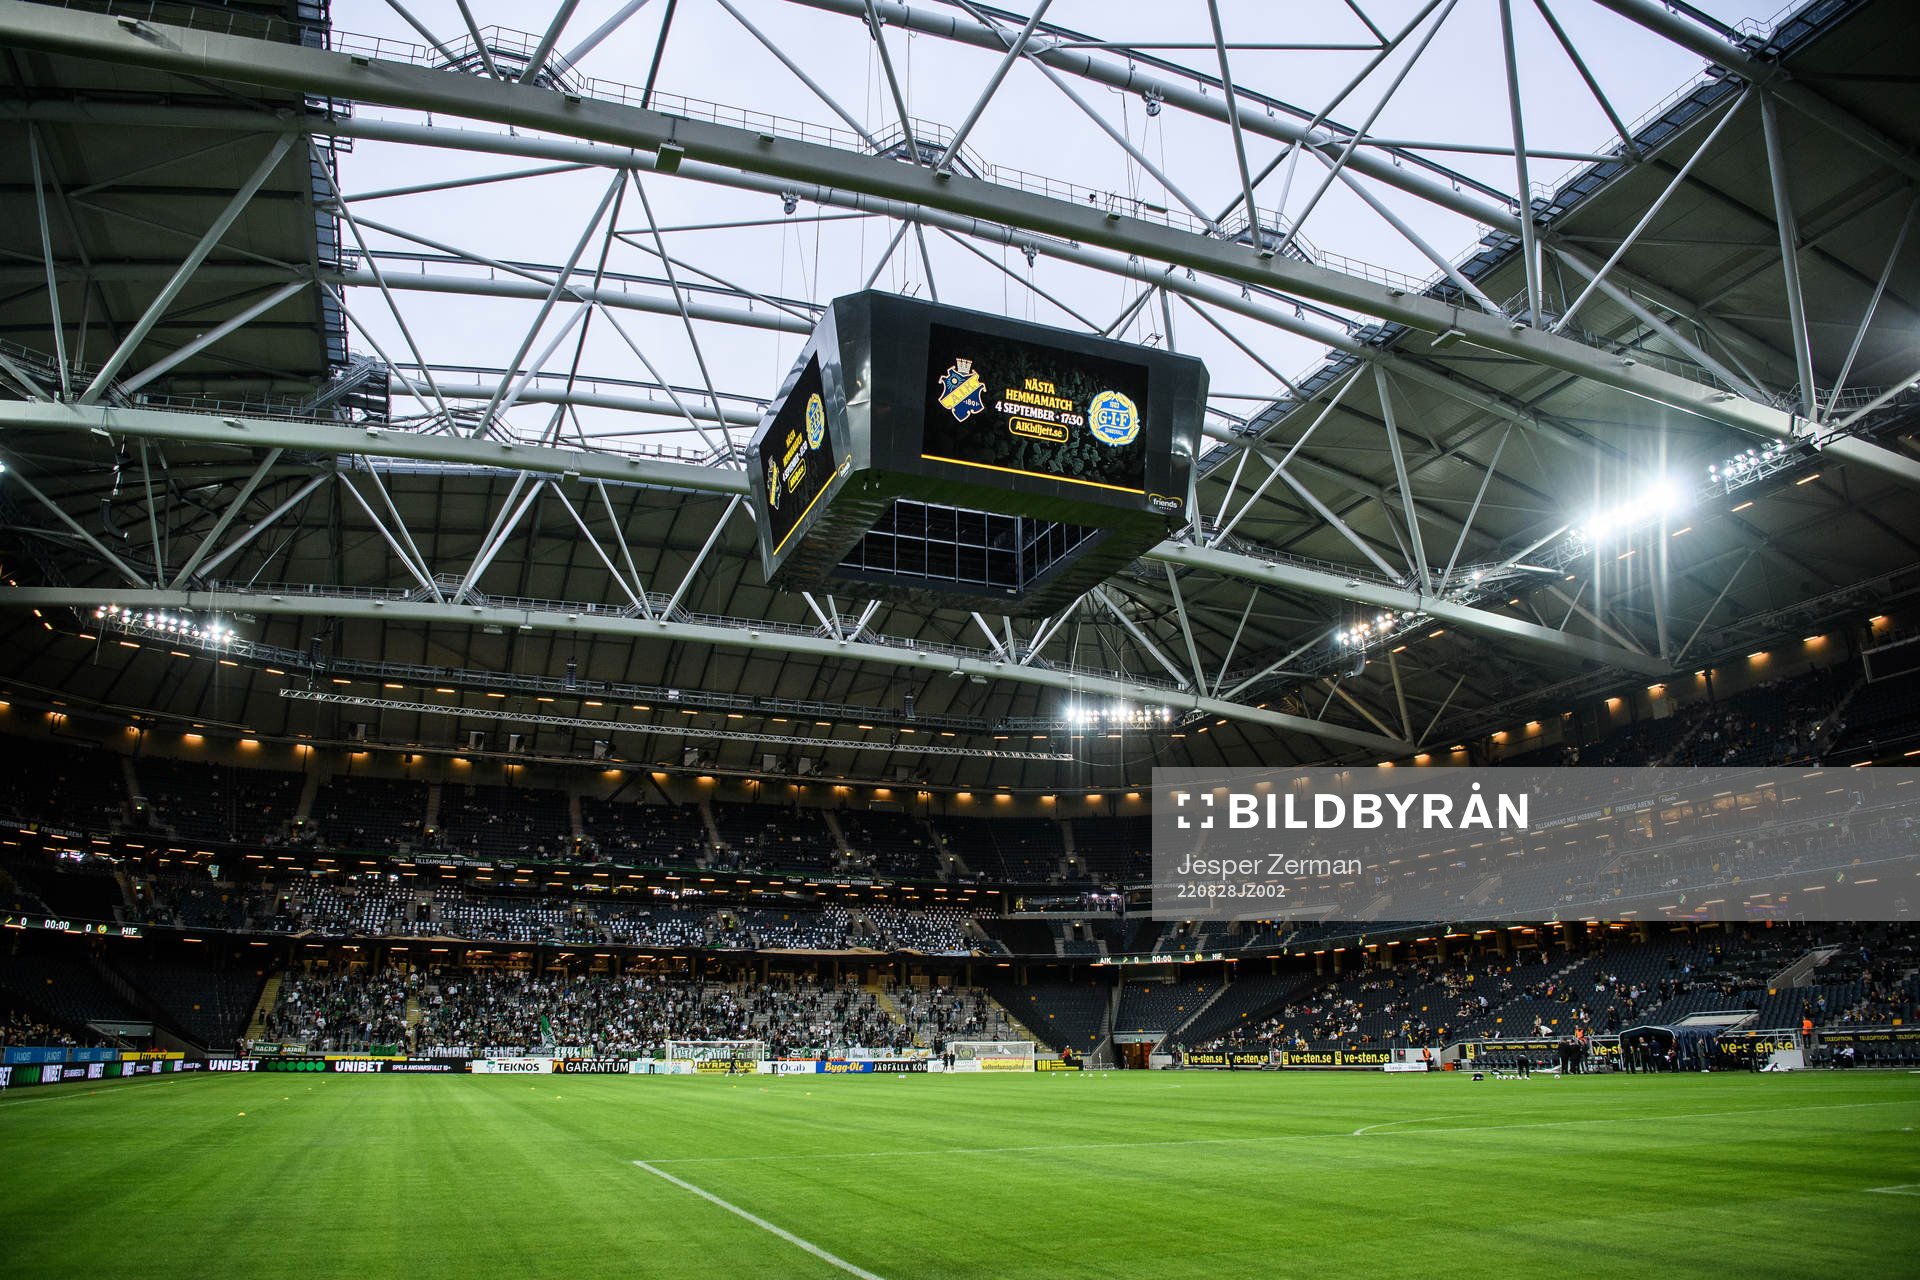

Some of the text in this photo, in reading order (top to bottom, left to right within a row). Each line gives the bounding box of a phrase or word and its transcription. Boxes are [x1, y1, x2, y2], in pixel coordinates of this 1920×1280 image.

[1024, 378, 1056, 395] NÄSTA
[1006, 389, 1073, 411] HEMMAMATCH
[995, 401, 1083, 428] 4 SEPTEMBER 17:30
[1015, 421, 1063, 439] AIKbiljett.se
[1153, 498, 1178, 509] friends
[1615, 804, 1637, 814] FRIENDS
[1637, 800, 1656, 810] ARENA
[20, 917, 138, 935] 0 00:00 0 HIF
[1152, 955, 1172, 963] 00:00
[1190, 1055, 1223, 1064] ve-sten.se
[1290, 1052, 1332, 1063] ve-sten.se
[1344, 1052, 1391, 1063] ve-sten.se
[209, 1060, 260, 1071] UNIBET
[335, 1061, 385, 1072] UNIBET
[497, 1063, 540, 1072] TEKNOS
[565, 1062, 629, 1073] GARANTUM
[697, 1061, 757, 1069] HYRPOLEN
[780, 1062, 806, 1072] Ocab
[825, 1061, 865, 1073] Bygg-Ole
[873, 1061, 928, 1071] JÄRFÄLLA KÖK
